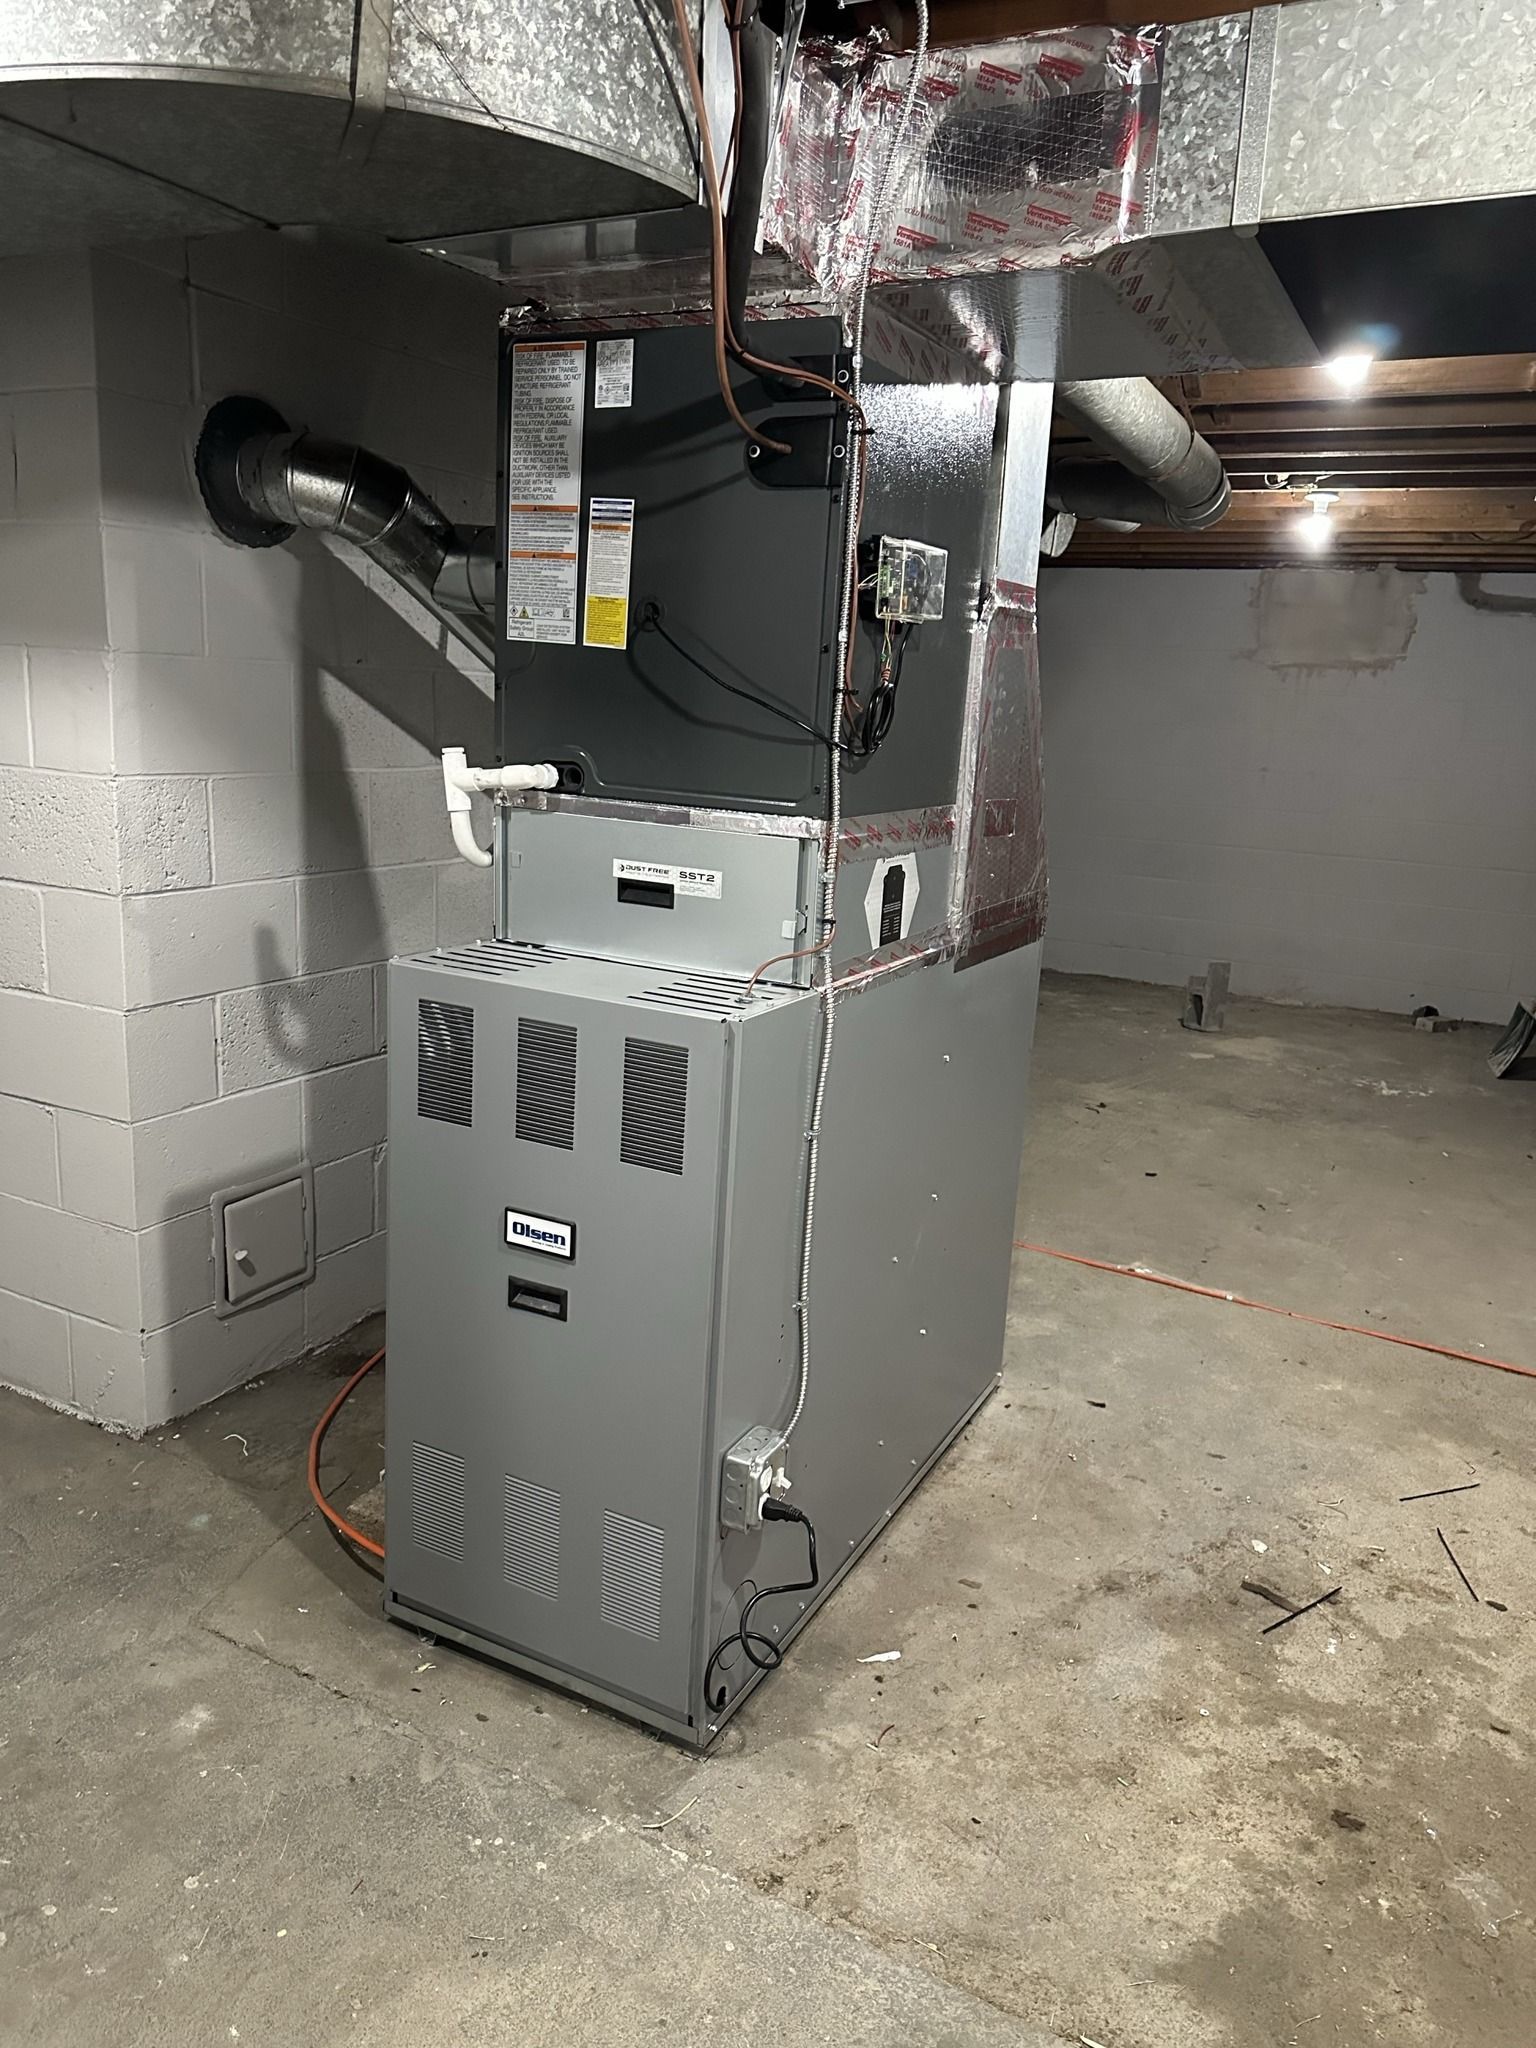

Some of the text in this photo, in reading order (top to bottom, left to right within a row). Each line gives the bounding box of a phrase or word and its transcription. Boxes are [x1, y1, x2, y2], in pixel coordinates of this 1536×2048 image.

[546, 351, 573, 359] FLAMMABLE
[540, 381, 572, 389] REFRIGERANT
[679, 871, 715, 882] SST2
[512, 1221, 566, 1246] Olsen
